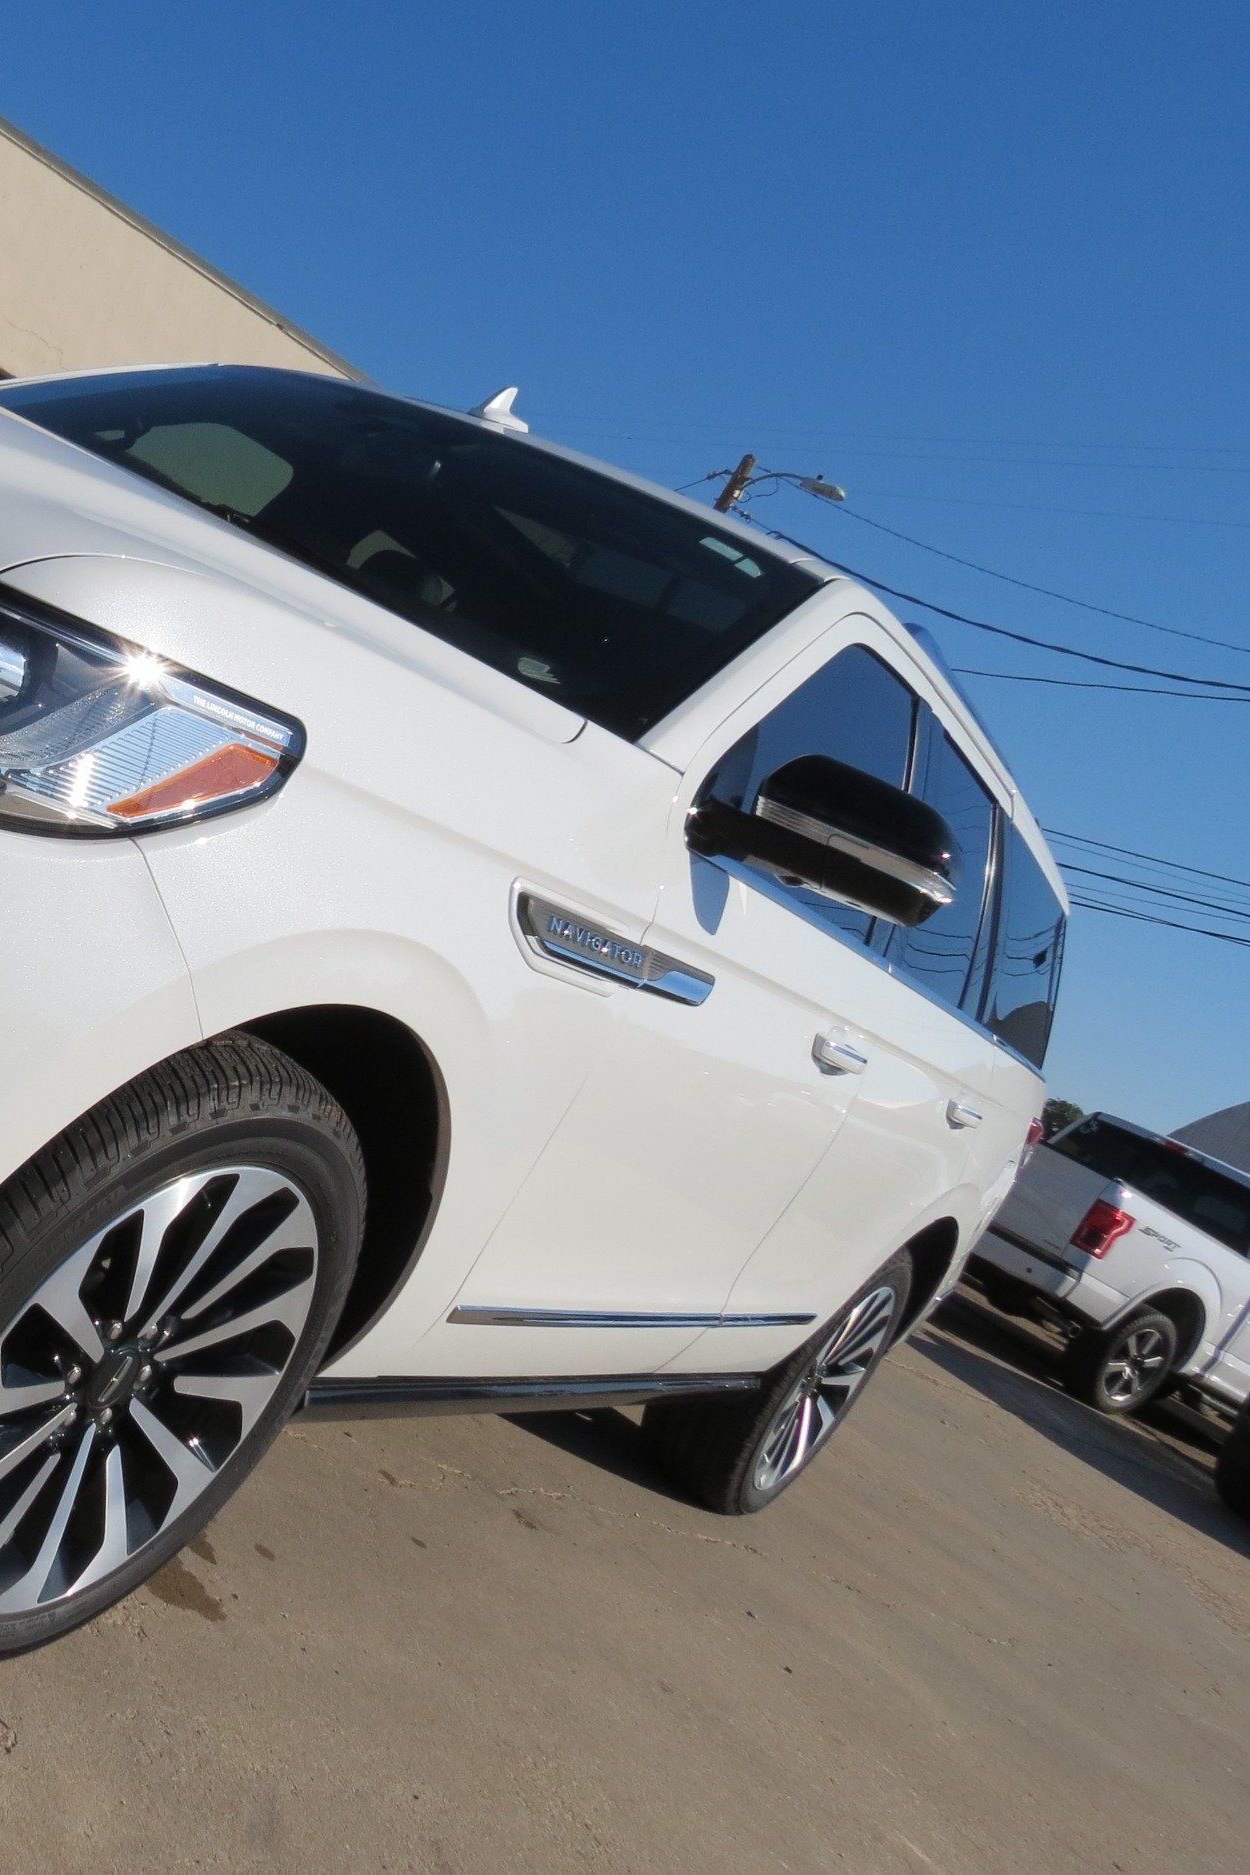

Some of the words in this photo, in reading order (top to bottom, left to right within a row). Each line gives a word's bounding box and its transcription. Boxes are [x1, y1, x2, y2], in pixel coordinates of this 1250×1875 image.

[192, 694, 207, 708] THE
[206, 701, 235, 721] LINCOLN
[232, 712, 257, 730] MOTOR
[255, 720, 285, 741] COMPANY
[548, 915, 645, 968] NAVIGATOR
